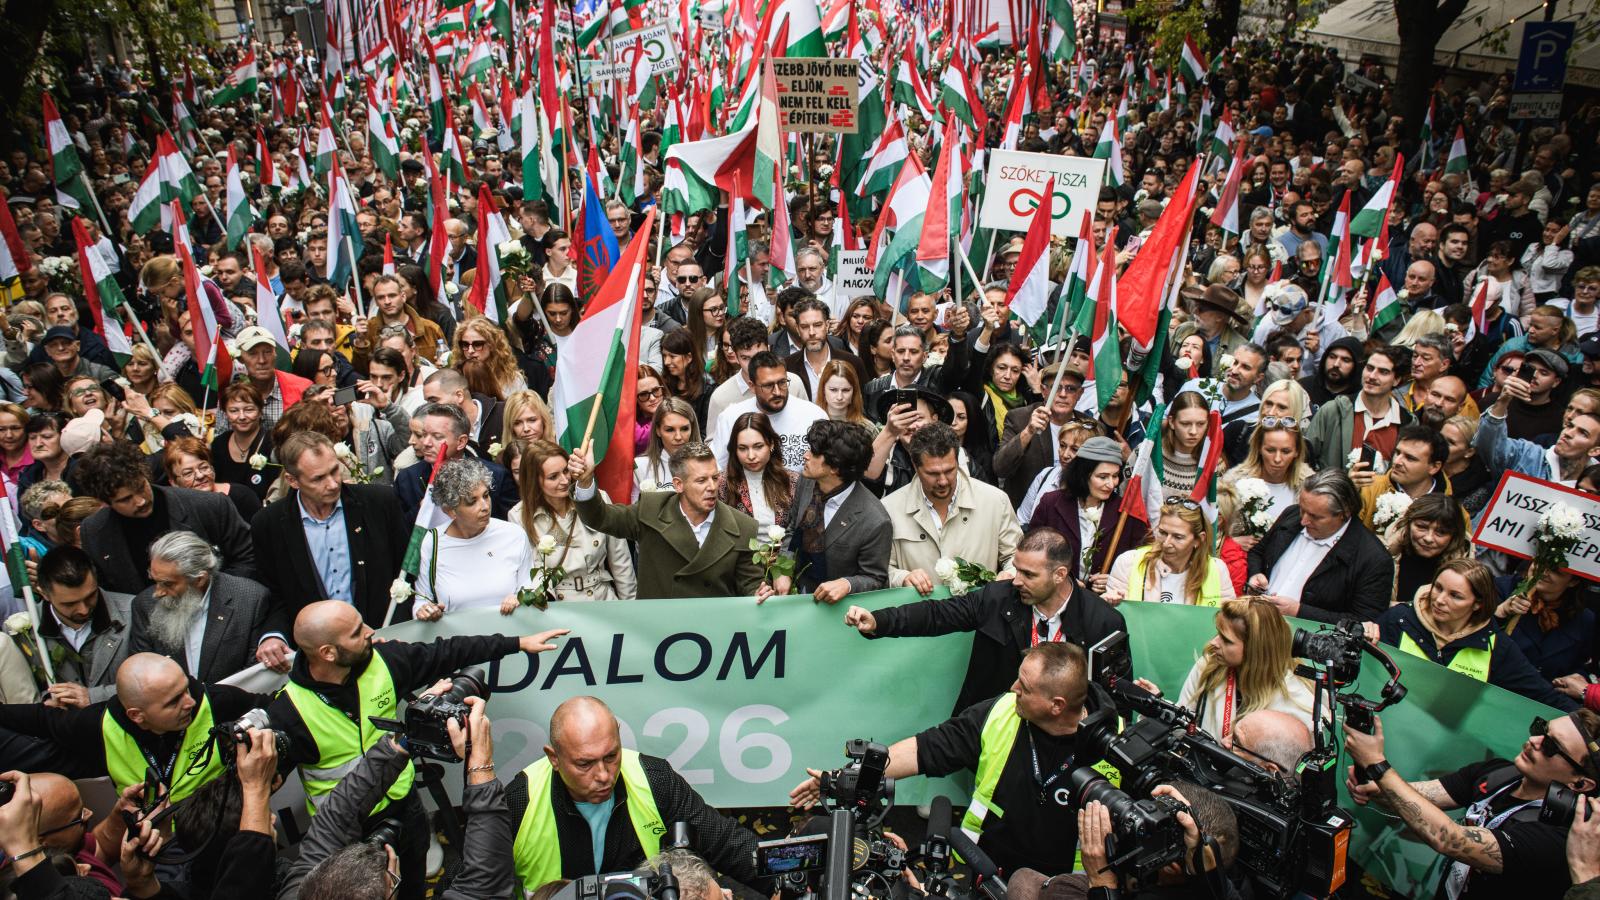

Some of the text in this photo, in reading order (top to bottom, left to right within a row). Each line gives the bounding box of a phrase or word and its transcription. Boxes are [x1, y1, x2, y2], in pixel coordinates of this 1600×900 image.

[1533, 40, 1557, 70] P
[806, 60, 831, 77] JÖVŐ
[834, 64, 857, 77] NEM
[806, 97, 823, 108] FEL
[827, 97, 852, 110] KELL
[789, 109, 830, 124] ÉPÍTENI
[999, 164, 1088, 188] SZŐKE TISZA
[842, 256, 867, 265] MILLIÓ
[842, 279, 874, 289] MAGYA
[1487, 516, 1525, 539] AMI
[491, 704, 793, 785] 226
